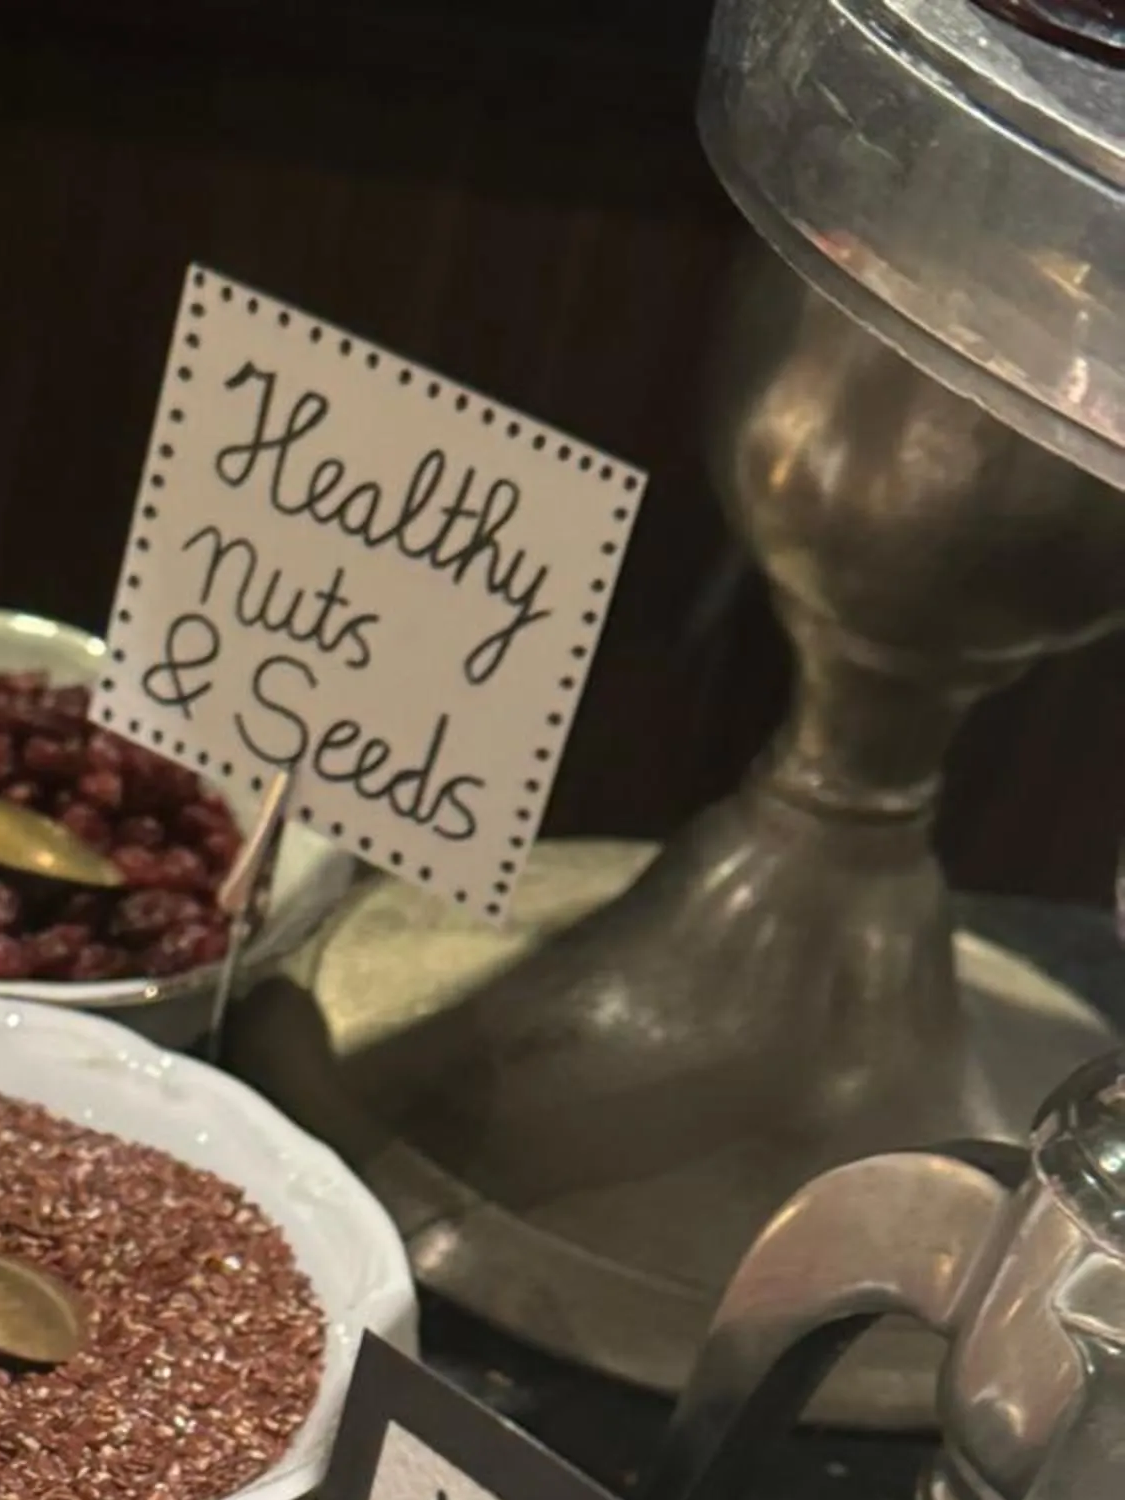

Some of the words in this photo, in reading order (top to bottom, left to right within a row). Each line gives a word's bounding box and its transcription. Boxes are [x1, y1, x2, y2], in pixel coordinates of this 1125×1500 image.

[181, 525, 379, 670] nuts
[215, 361, 551, 686] Healthy
[141, 613, 221, 720] &
[233, 654, 486, 841] Seeds
